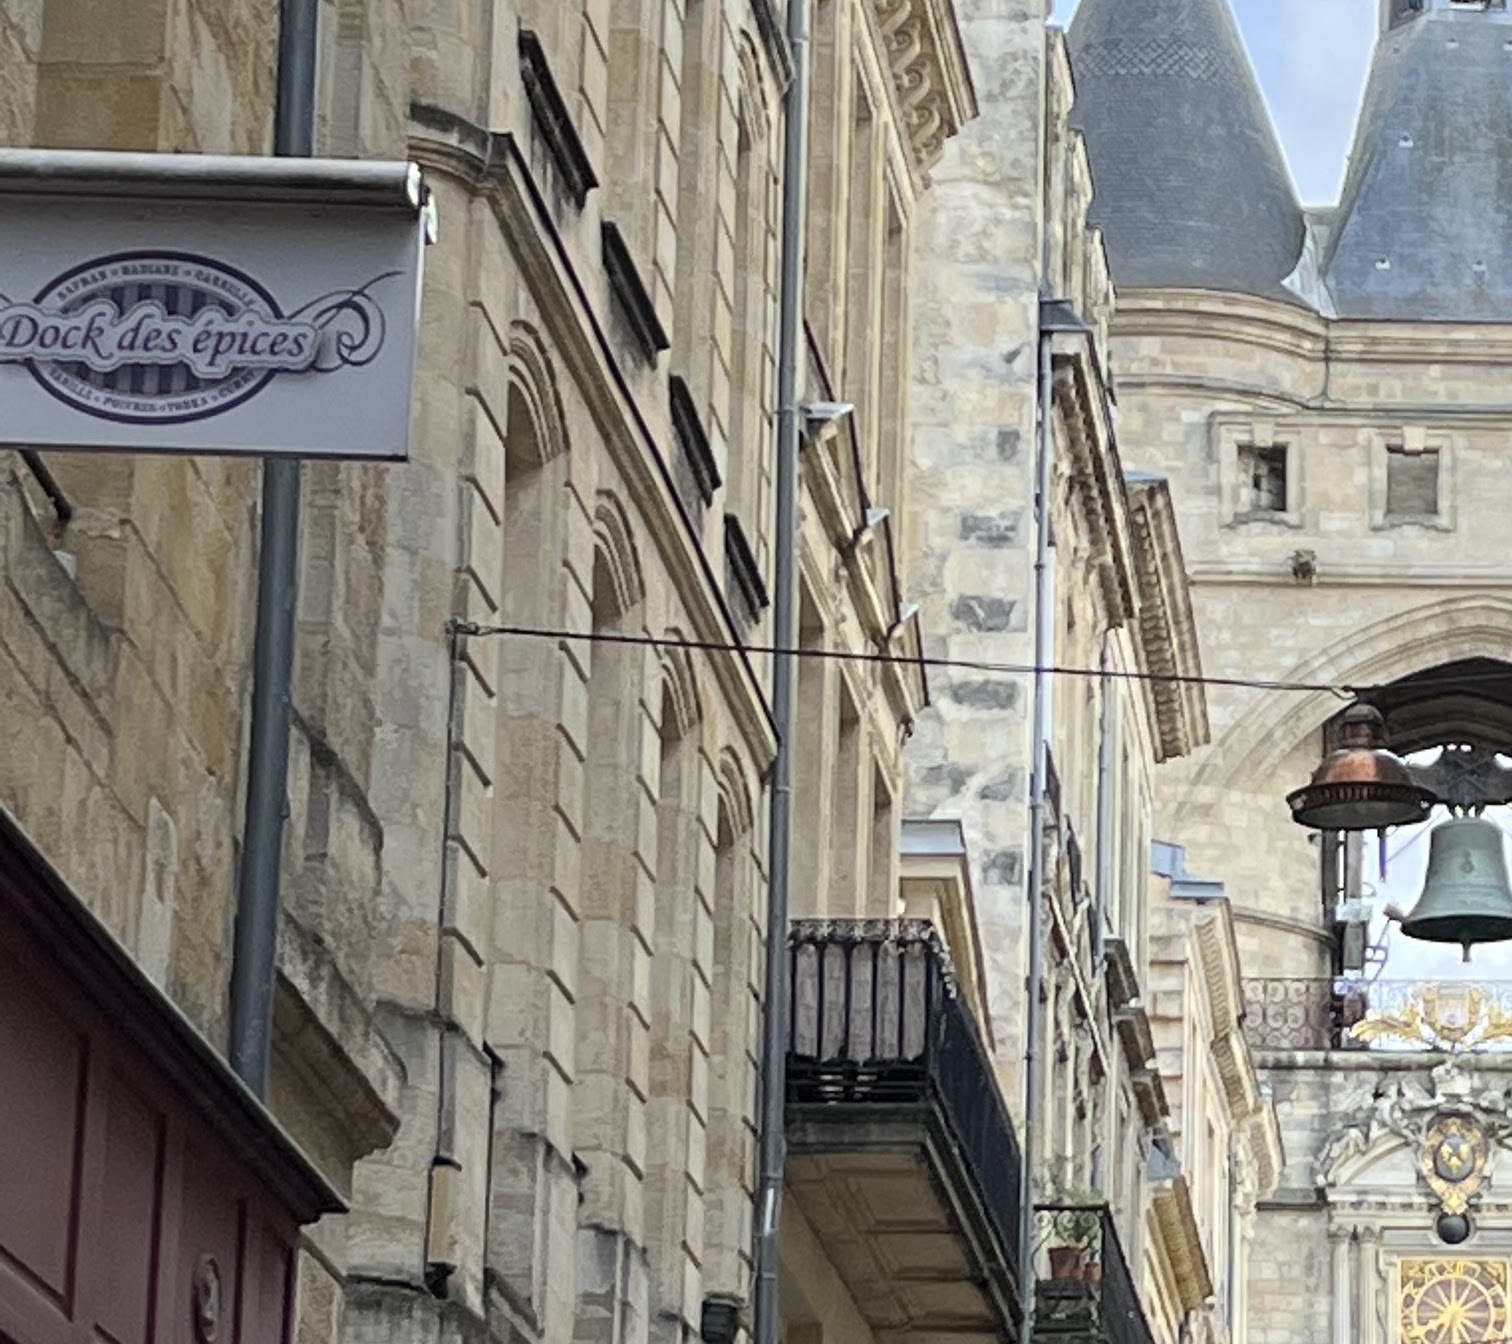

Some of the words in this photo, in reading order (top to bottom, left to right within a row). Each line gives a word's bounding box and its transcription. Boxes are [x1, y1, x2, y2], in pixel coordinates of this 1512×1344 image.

[2, 312, 114, 358] Dock
[117, 313, 183, 352] des
[192, 319, 309, 367] épices
